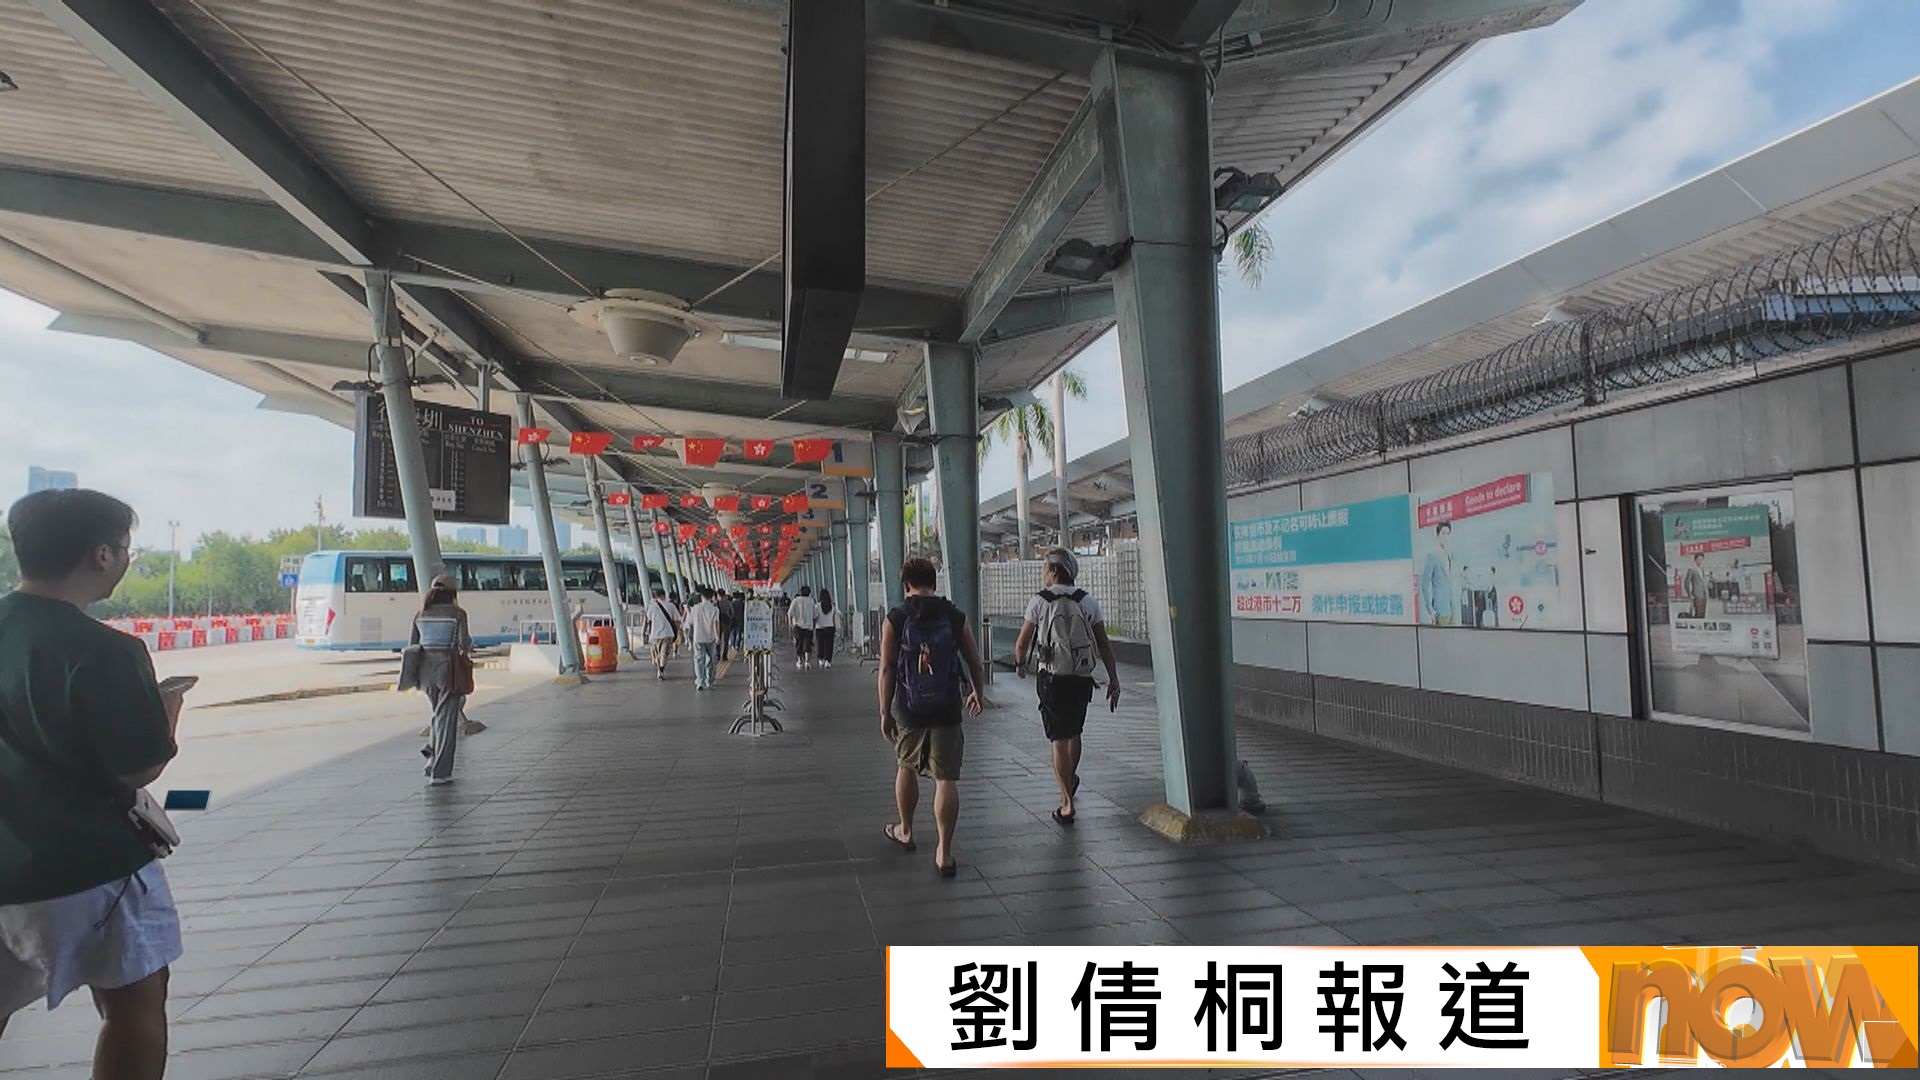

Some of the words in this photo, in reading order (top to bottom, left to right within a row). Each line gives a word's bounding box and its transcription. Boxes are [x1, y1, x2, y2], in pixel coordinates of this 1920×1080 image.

[471, 416, 484, 425] TO
[448, 423, 504, 440] SHENZHEN
[832, 442, 843, 463] 1
[810, 484, 828, 499] 2
[1464, 492, 1485, 505] Goods
[1486, 490, 1494, 499] to
[1495, 482, 1521, 498] declare
[1237, 595, 1302, 613] 超过港币十二万
[1312, 593, 1404, 615] 须作申报或披露
